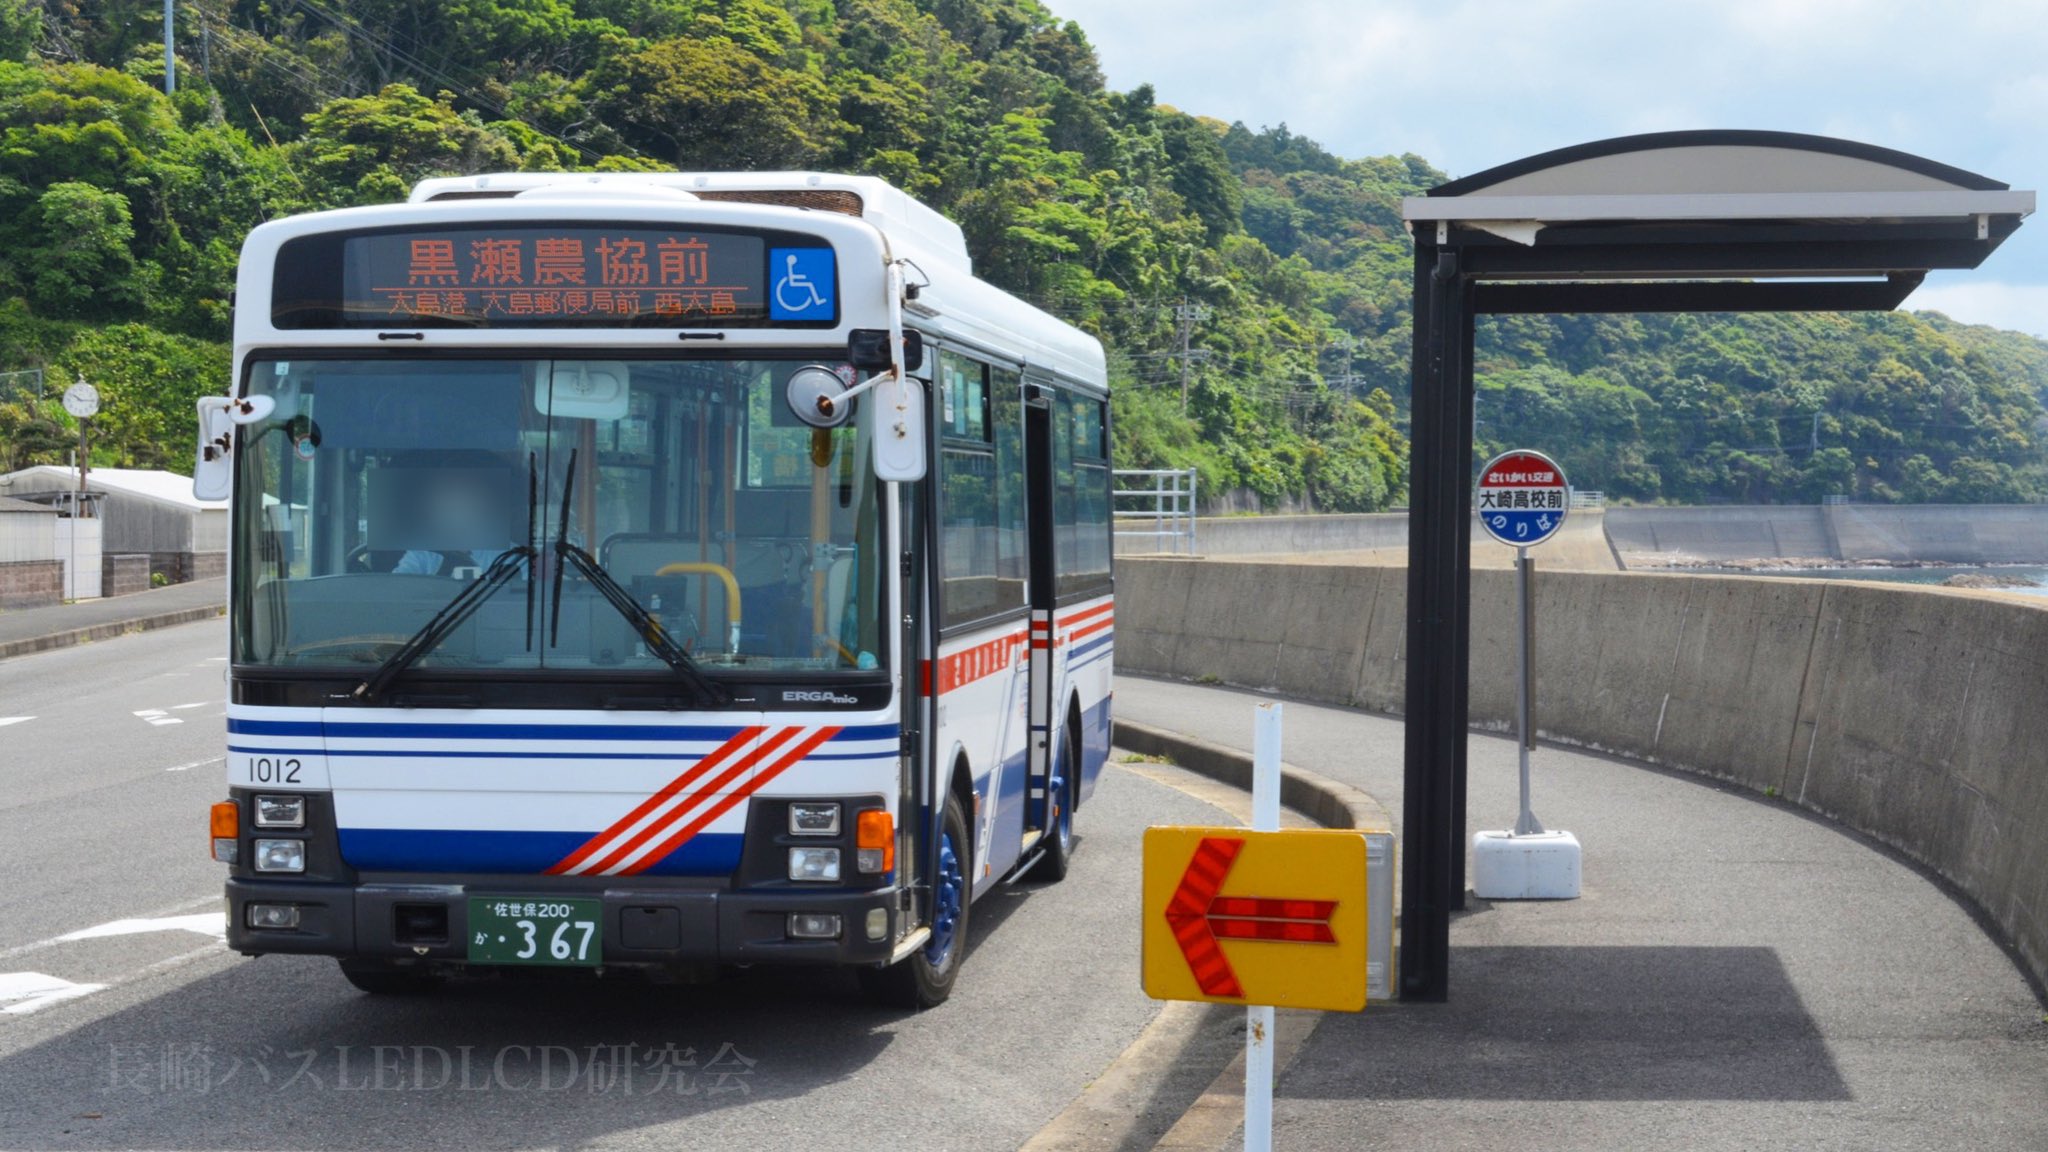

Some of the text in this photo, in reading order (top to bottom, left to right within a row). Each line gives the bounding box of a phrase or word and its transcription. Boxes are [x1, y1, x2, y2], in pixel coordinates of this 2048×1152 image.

[409, 238, 709, 285] 黒瀬農協前
[388, 291, 737, 315] 大島港 大島郵便局前 西大島
[1489, 472, 1554, 482] さいかい交通
[1480, 490, 1562, 509] 大崎高校前
[1492, 513, 1552, 537] のりば
[250, 757, 302, 783] 1012
